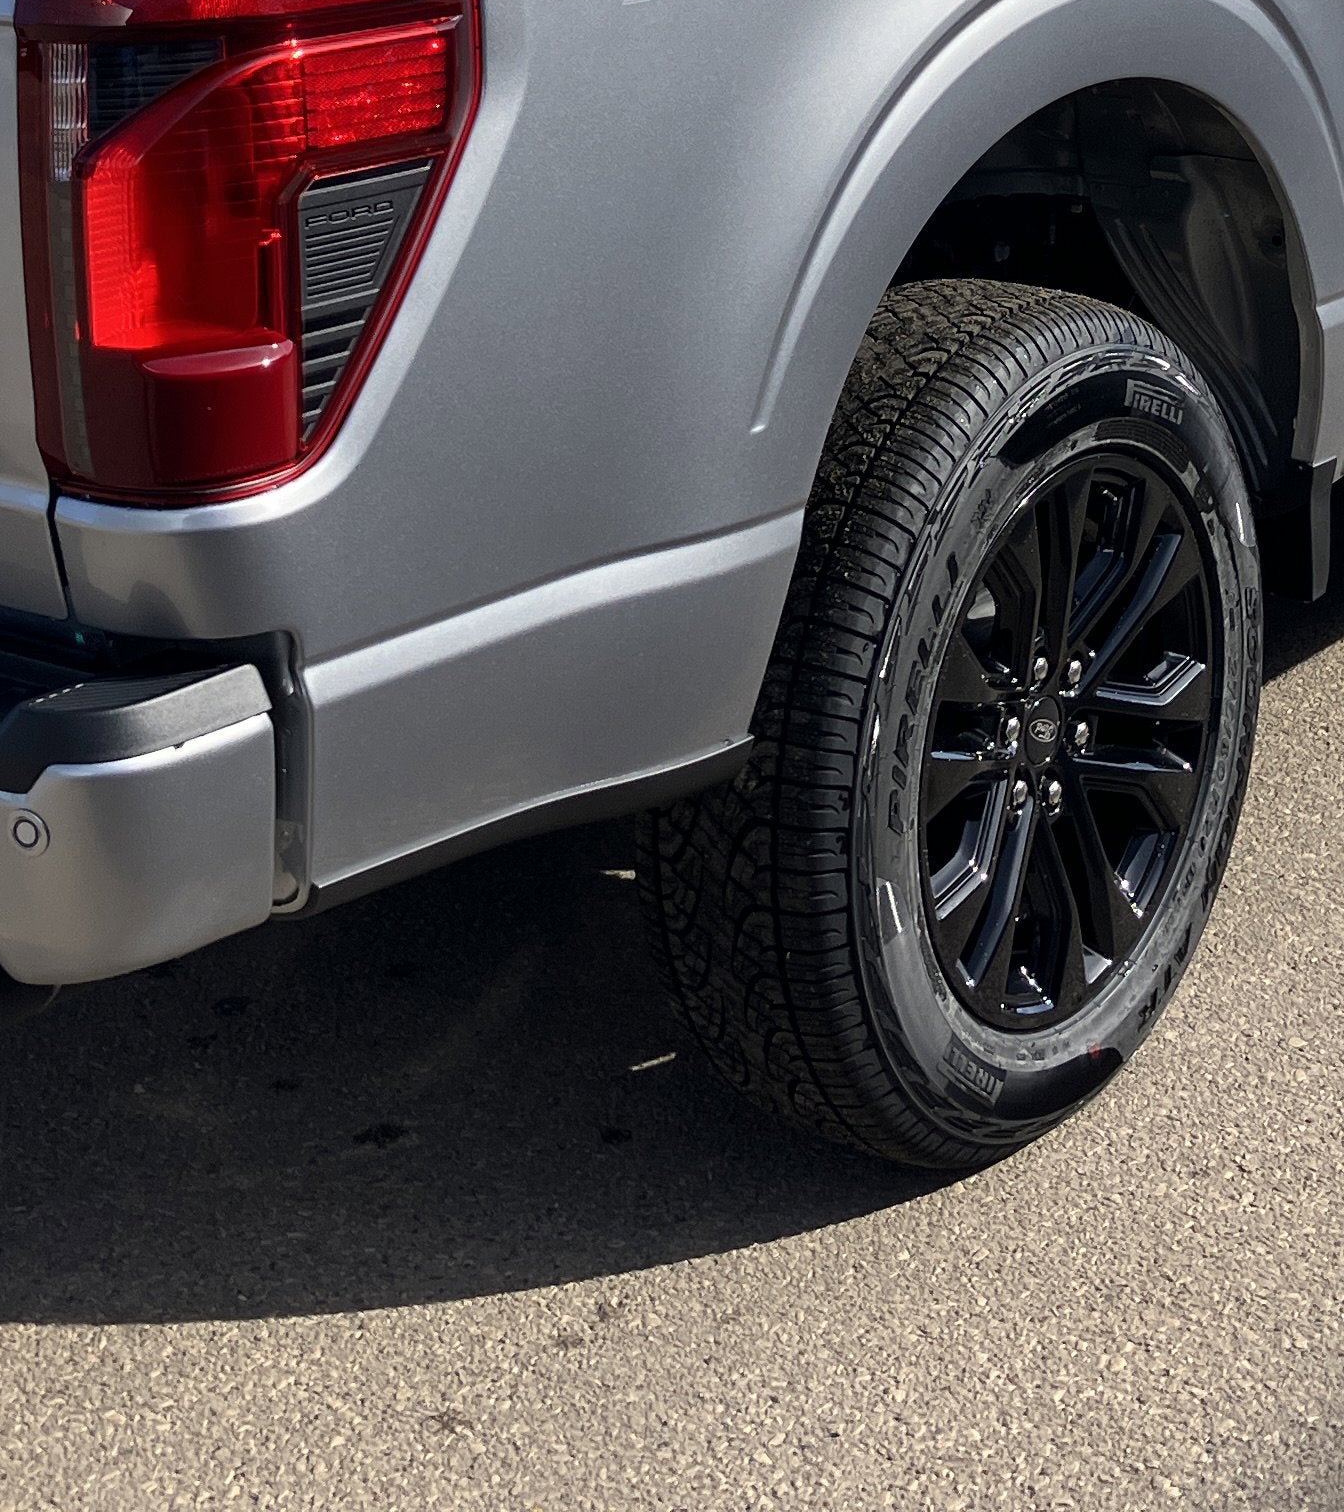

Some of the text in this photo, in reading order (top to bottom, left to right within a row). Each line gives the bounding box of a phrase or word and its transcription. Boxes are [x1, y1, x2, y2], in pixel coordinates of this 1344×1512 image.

[304, 200, 394, 230] FORD
[1124, 377, 1185, 426] PIRELLI
[887, 550, 960, 836] PIRELLI
